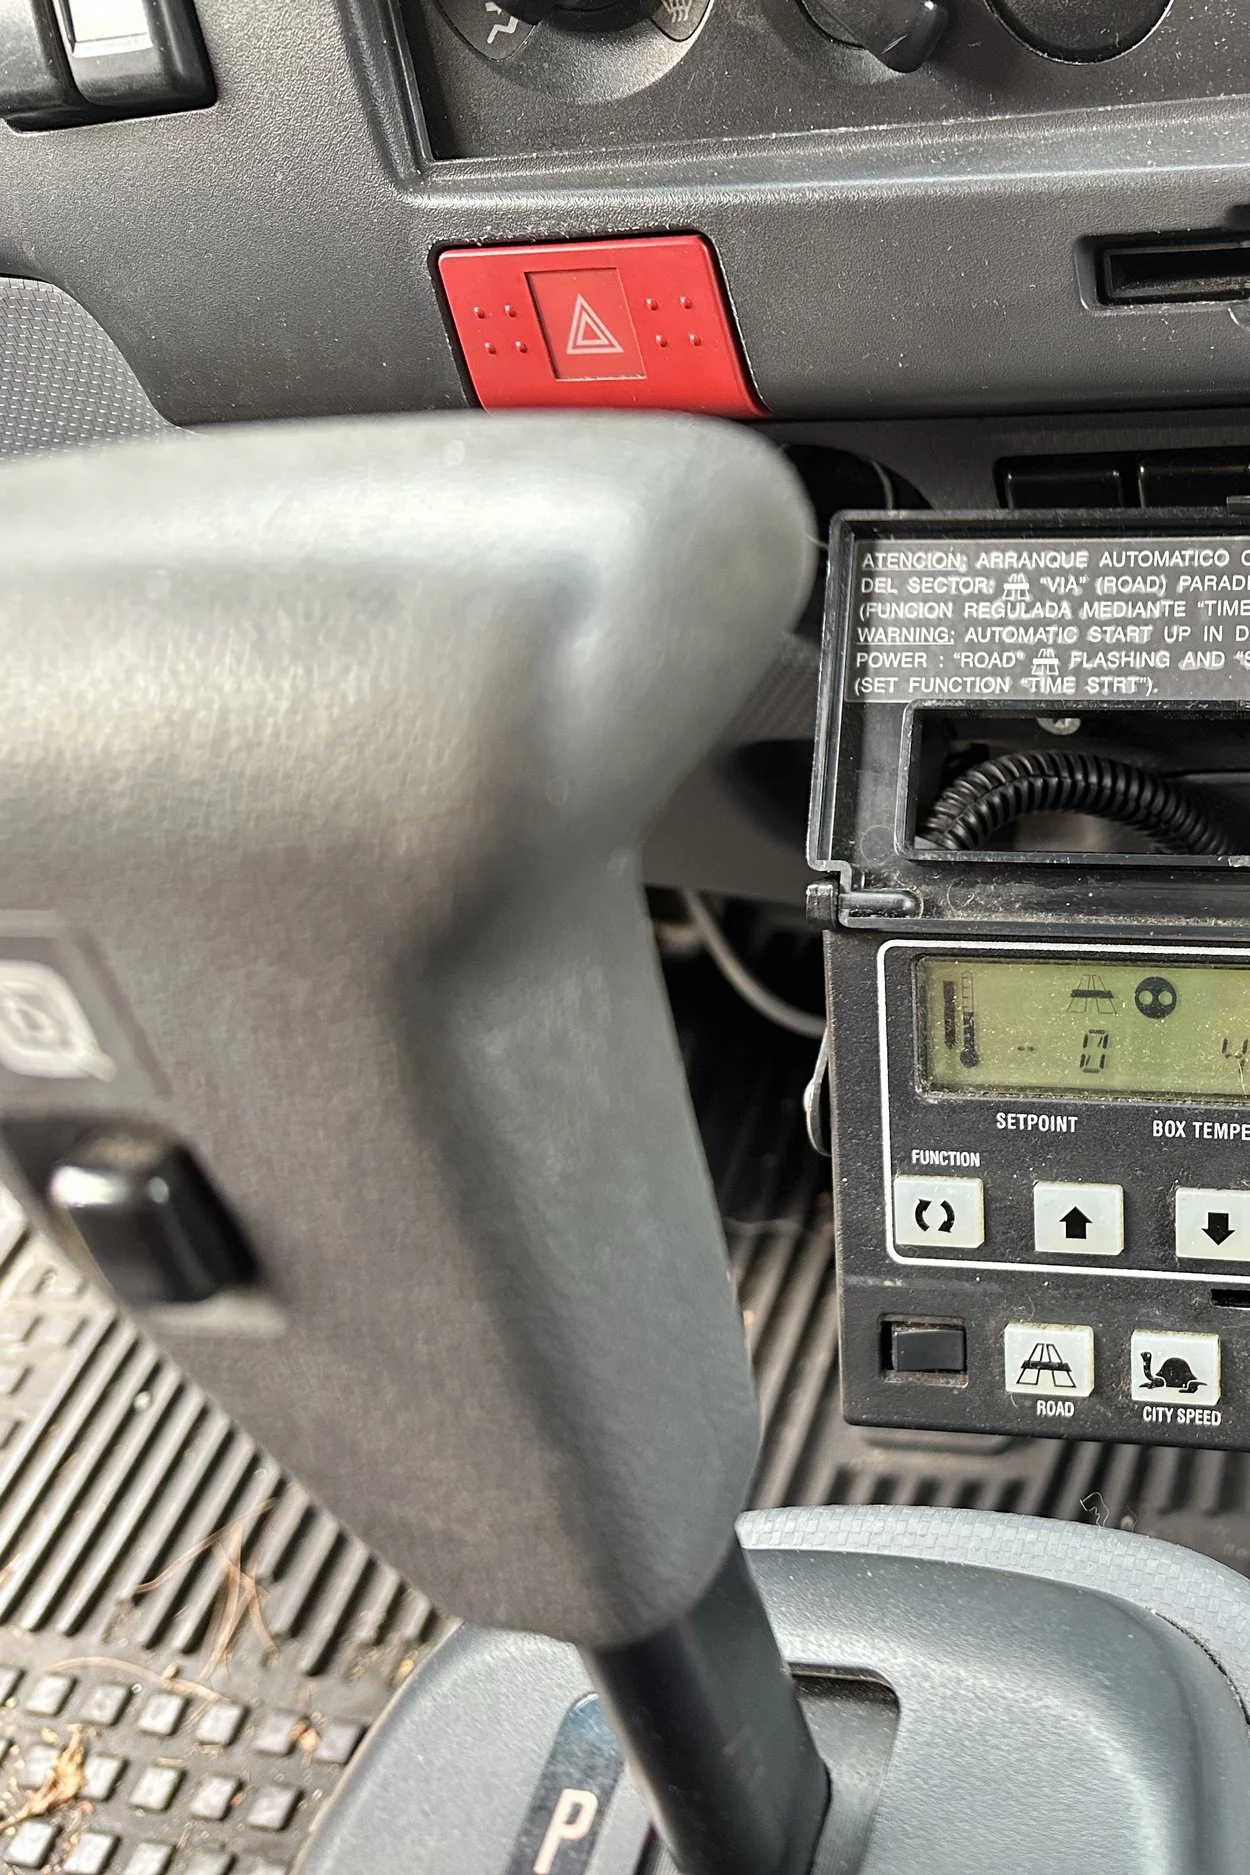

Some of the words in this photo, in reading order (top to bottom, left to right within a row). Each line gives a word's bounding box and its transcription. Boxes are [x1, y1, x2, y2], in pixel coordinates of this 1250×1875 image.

[862, 552, 967, 571] ATENCION:
[976, 551, 1089, 569] ARRANQUE
[1100, 550, 1230, 567] AUTOMATICO
[861, 577, 897, 594] DEL
[907, 577, 995, 594] SECTOR:
[1096, 575, 1167, 596] (ROAD)
[859, 602, 953, 621] (FUNCION
[965, 601, 1071, 619] REGULADA
[1081, 601, 1186, 618] MEDIANTE
[857, 627, 955, 645] WARNING:
[965, 626, 1078, 644] AUTOMATIC
[1089, 626, 1153, 643] START
[1164, 626, 1192, 642] UP
[1204, 626, 1223, 642] IN
[856, 652, 927, 669] POWER
[1069, 651, 1170, 668] FLASHING
[1183, 651, 1225, 669] AND
[854, 677, 896, 696] (SET
[909, 676, 1010, 694] FUNCTION
[996, 1112, 1078, 1133] SETPOINT
[1152, 1119, 1186, 1139] BOX
[911, 1149, 980, 1168] FUNCTION
[1036, 1400, 1075, 1418] ROAD
[1142, 1405, 1173, 1424] CITY
[1177, 1408, 1222, 1427] SPEED
[533, 1788, 598, 1874] P
